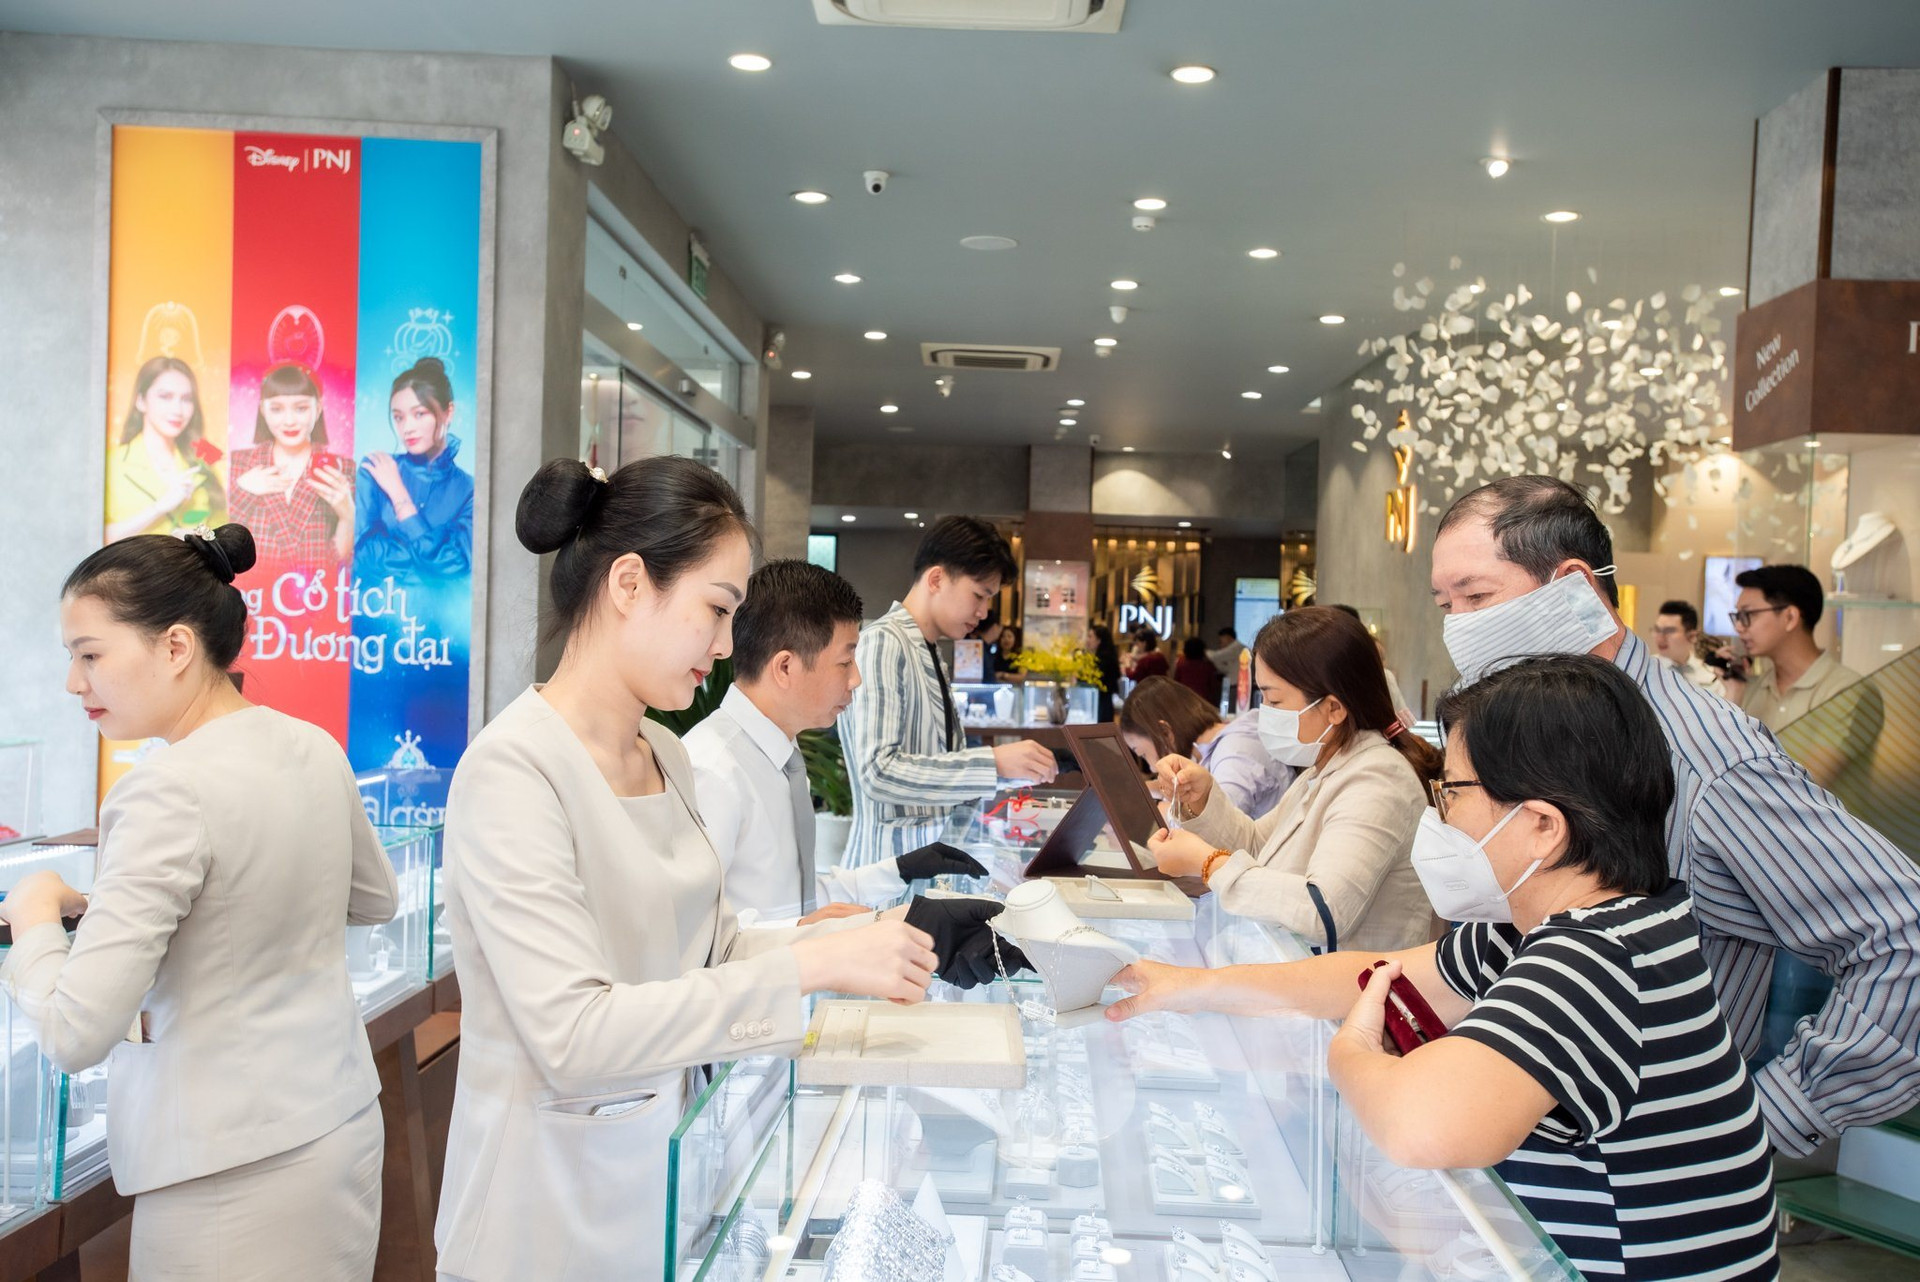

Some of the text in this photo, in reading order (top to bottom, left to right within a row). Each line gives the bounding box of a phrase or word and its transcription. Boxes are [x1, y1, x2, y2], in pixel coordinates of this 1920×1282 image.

[244, 145, 351, 174] Disney PNJ
[1756, 334, 1782, 369] New
[1745, 349, 1800, 412] Collection
[272, 569, 329, 617] Cổ
[334, 566, 417, 623] tích
[1119, 603, 1173, 641] PNJ
